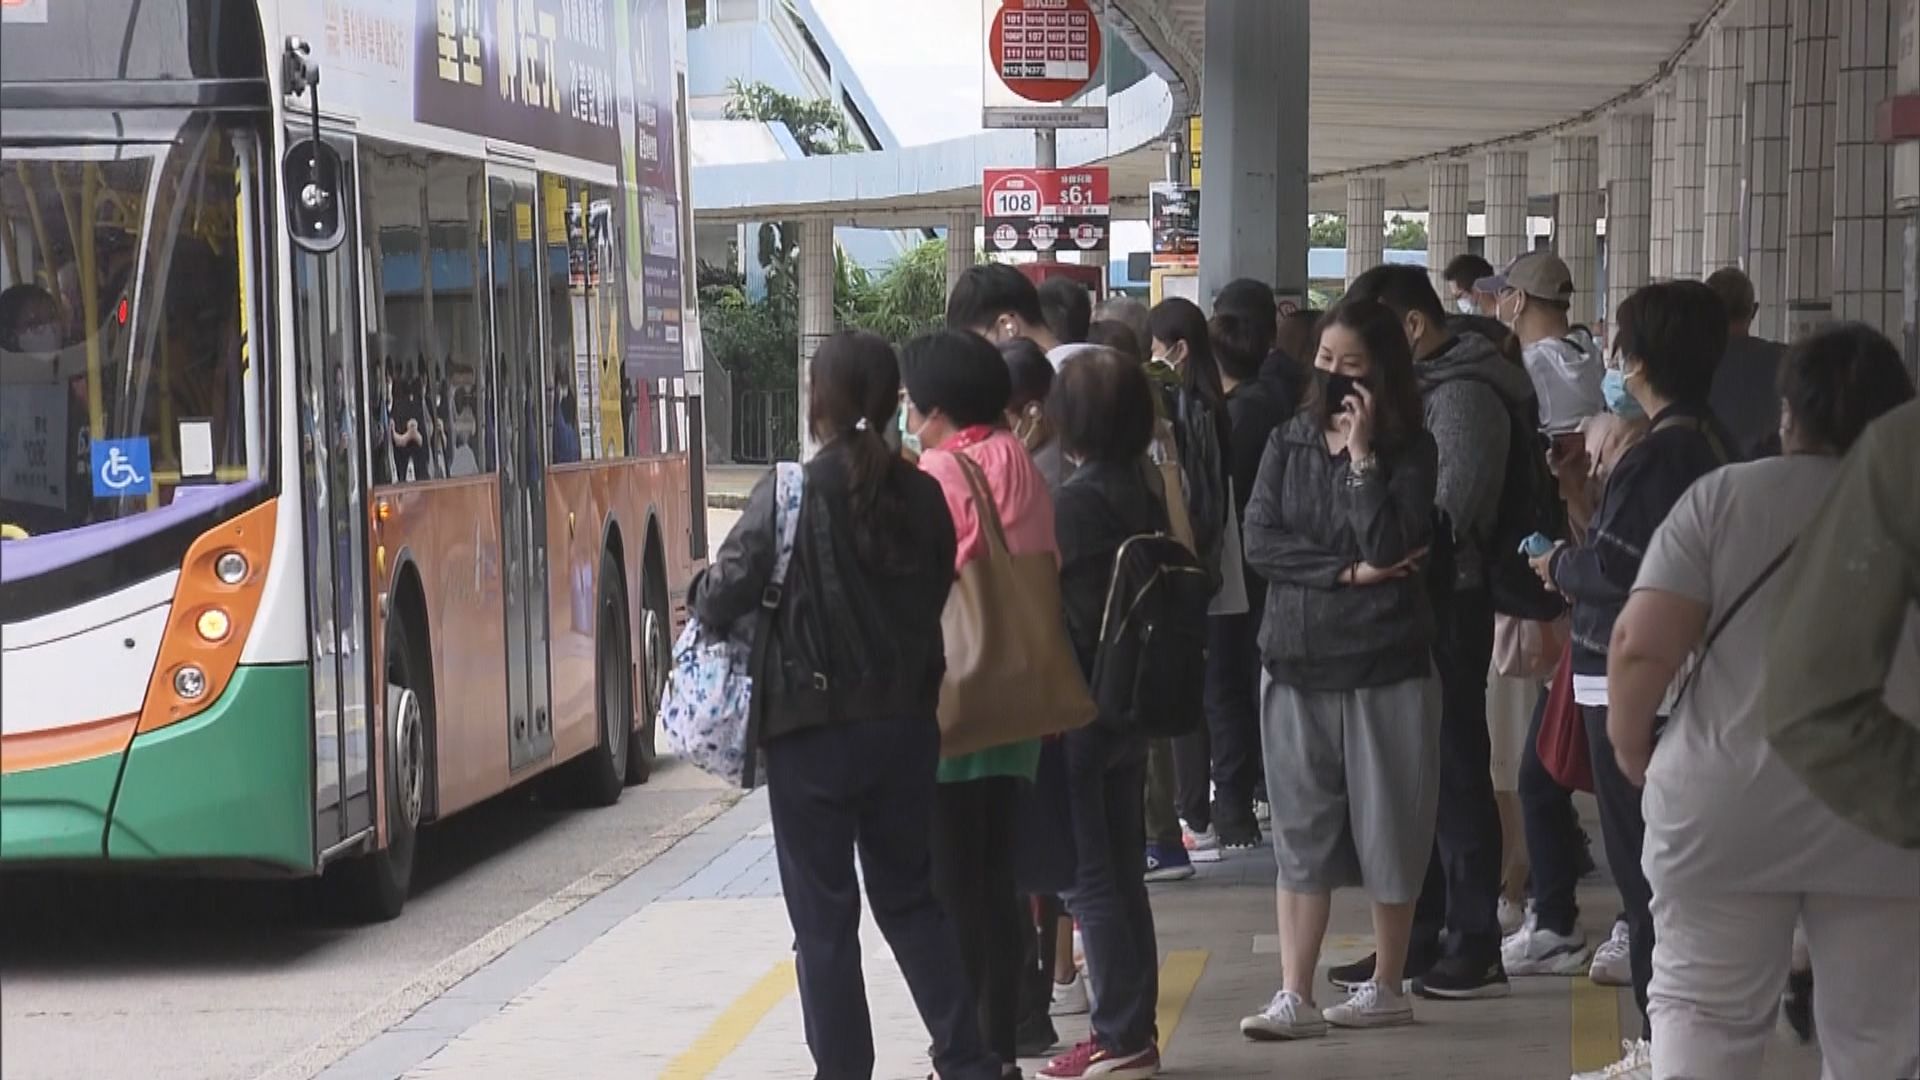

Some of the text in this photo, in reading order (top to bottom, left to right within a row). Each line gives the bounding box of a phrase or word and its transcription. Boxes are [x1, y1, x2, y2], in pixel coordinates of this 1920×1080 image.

[1006, 15, 1021, 24] 101
[1006, 49, 1021, 57] 111
[999, 194, 1031, 212] 108
